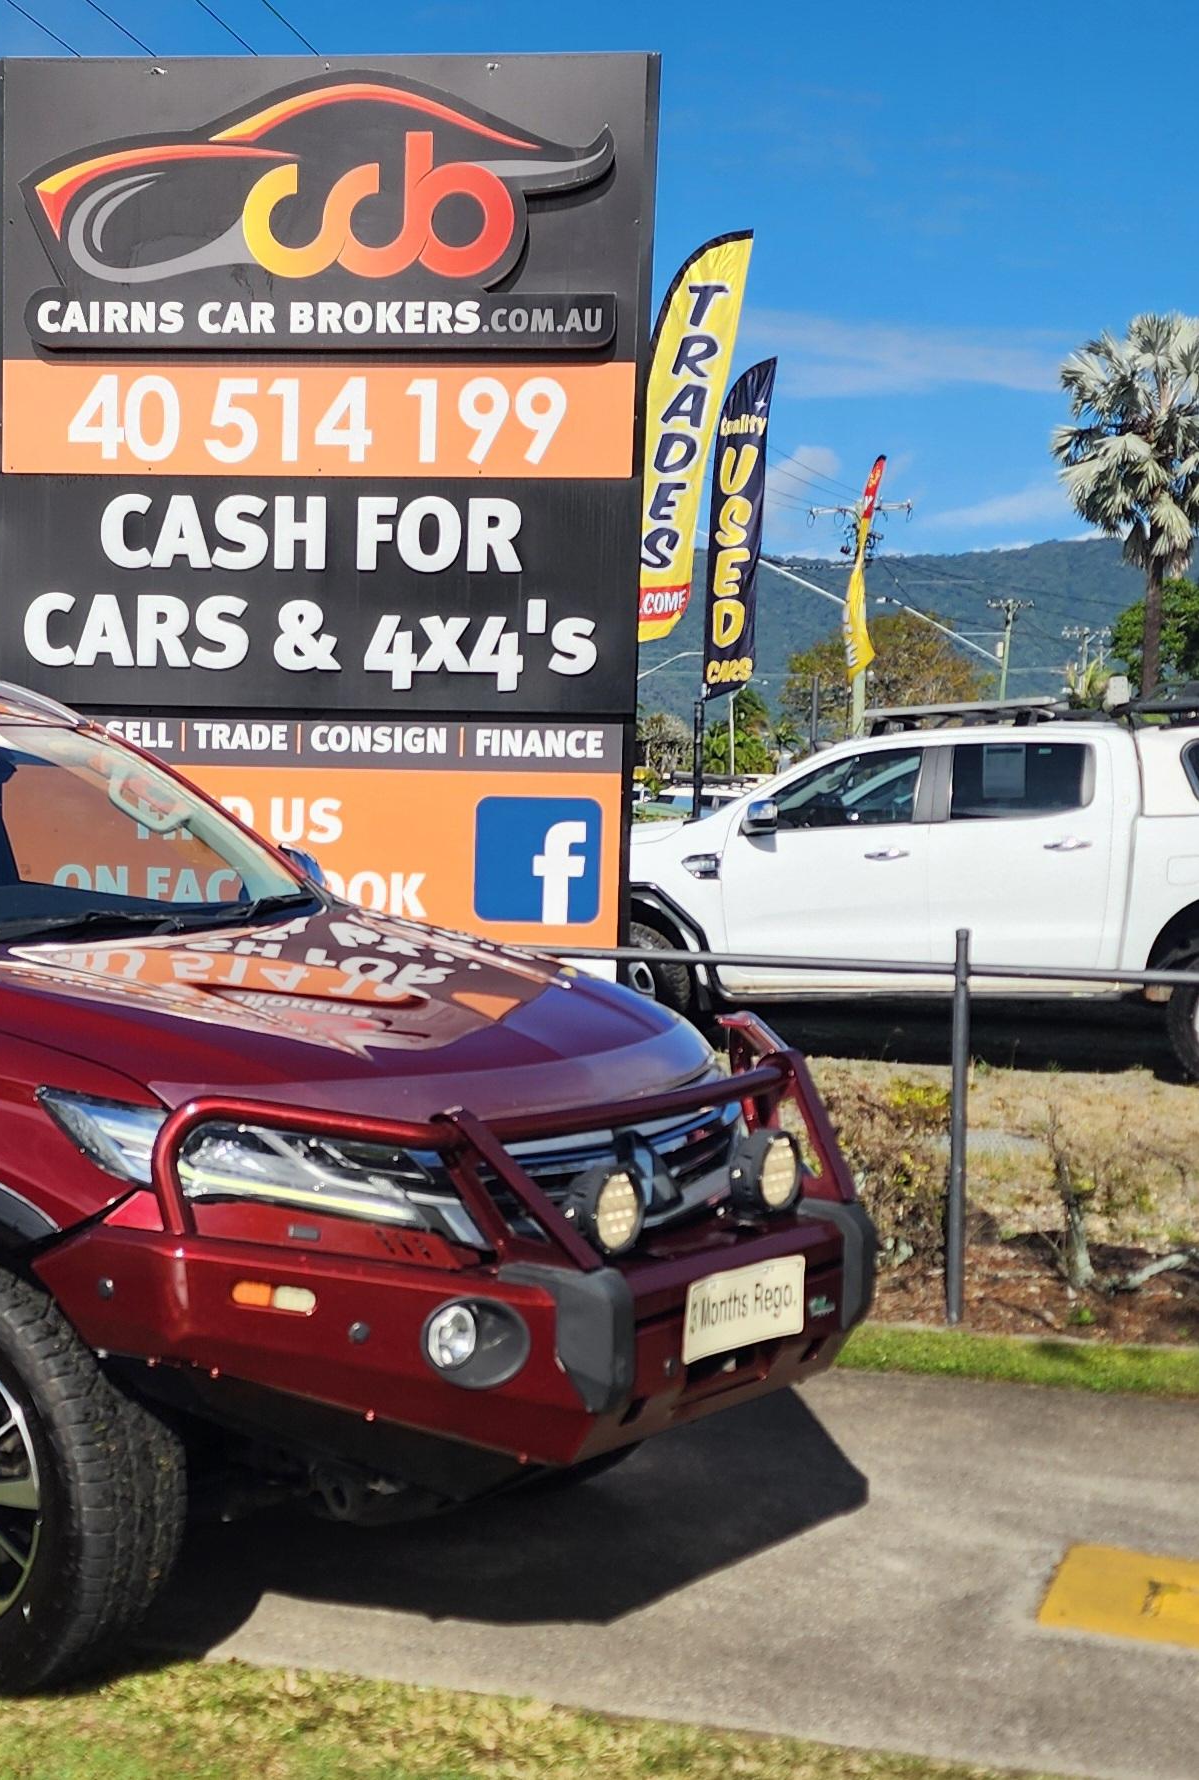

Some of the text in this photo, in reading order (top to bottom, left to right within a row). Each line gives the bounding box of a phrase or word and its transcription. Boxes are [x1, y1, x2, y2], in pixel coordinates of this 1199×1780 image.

[37, 300, 185, 333] CAIRNS
[198, 301, 276, 334] CAR
[67, 374, 568, 465] 40 514 199
[641, 284, 729, 569] TRADES
[100, 493, 523, 573] CASH FOR
[712, 443, 759, 649] USED
[639, 589, 687, 615] COME
[23, 592, 250, 670] CARS
[273, 599, 343, 671] &
[105, 720, 604, 759] SELL TRADE CONSIGN FINANCE
[137, 795, 344, 843] FD US
[146, 866, 429, 917] FACOK
[701, 1291, 748, 1330] Months
